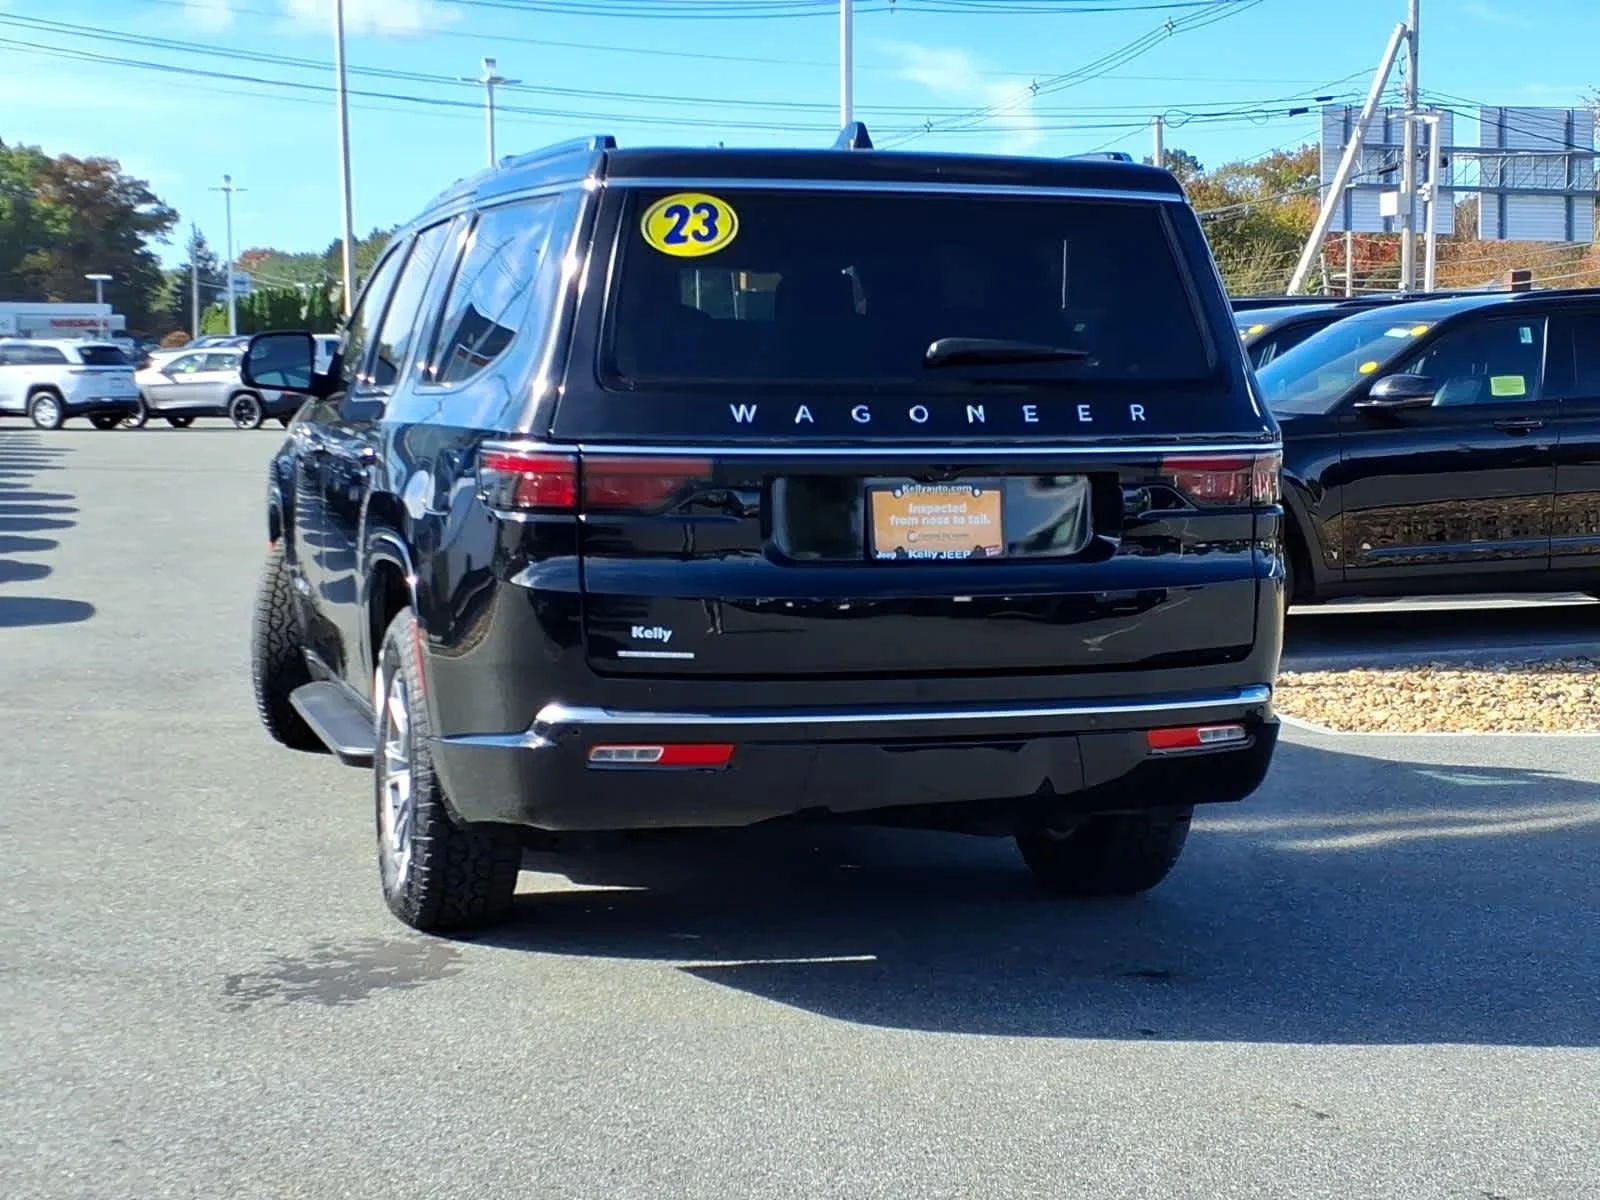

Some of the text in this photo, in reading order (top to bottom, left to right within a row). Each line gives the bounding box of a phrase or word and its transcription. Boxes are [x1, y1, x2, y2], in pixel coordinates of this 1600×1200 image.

[663, 203, 719, 245] 23
[730, 403, 1147, 424] WAGONEER
[909, 503, 968, 515] Inspected
[890, 514, 919, 526] from
[922, 515, 950, 526] nose
[952, 514, 966, 526] to
[908, 550, 972, 560] Kelly JEEP
[631, 625, 672, 643] Kelly
